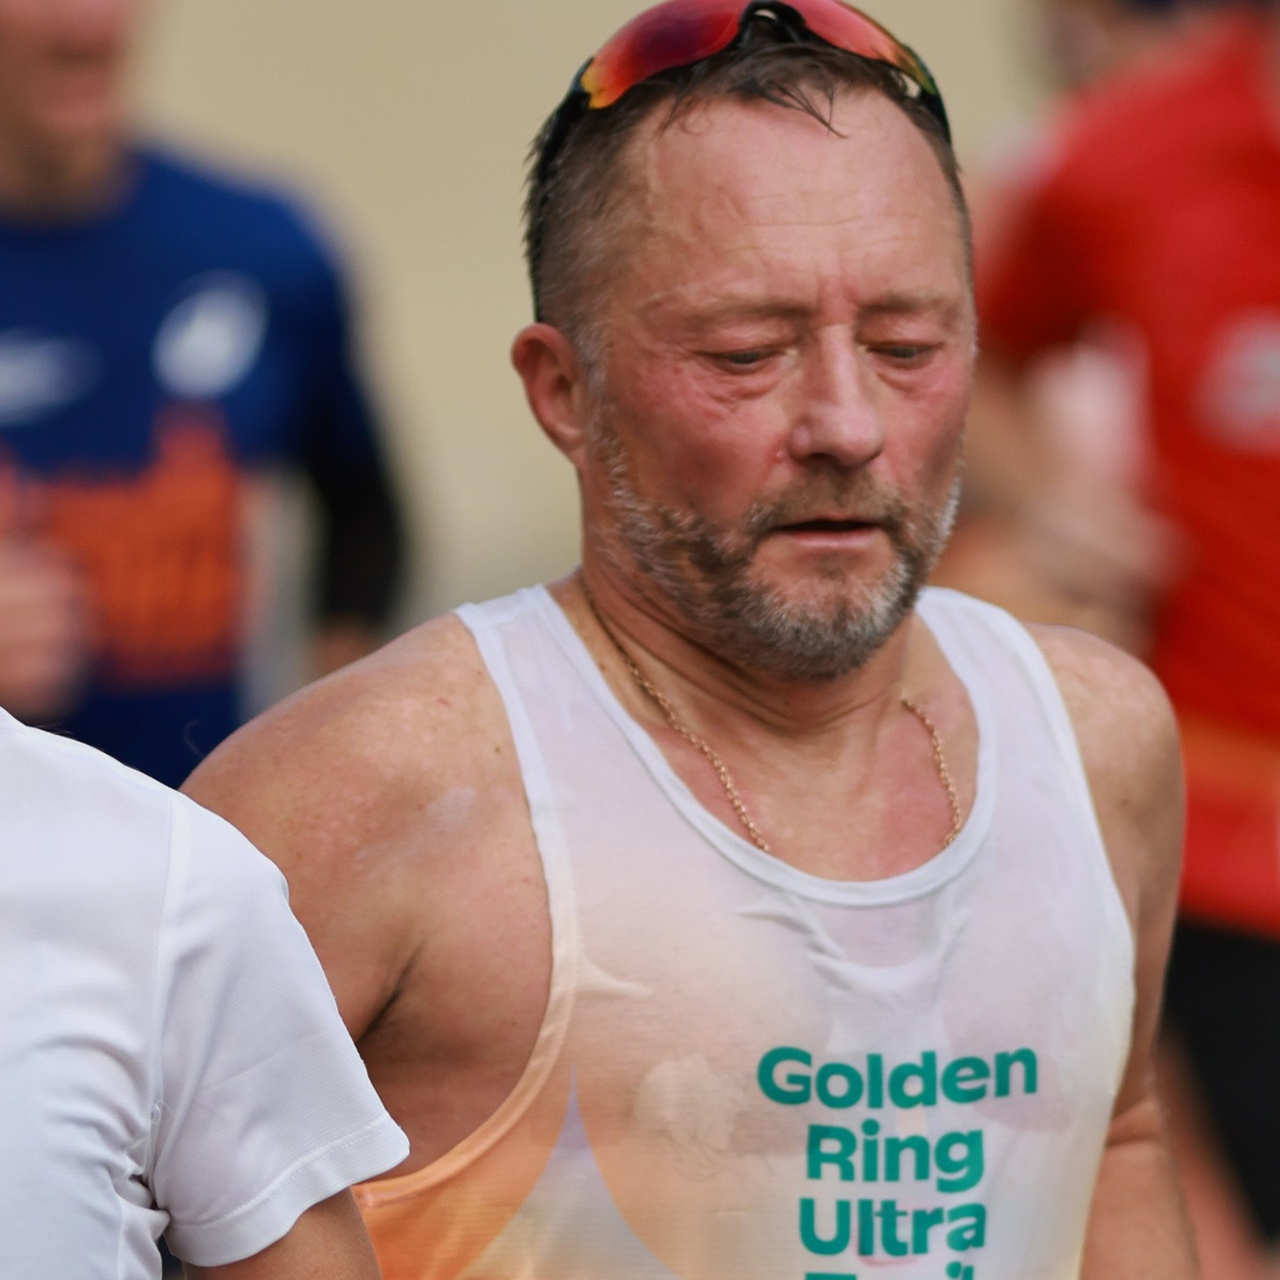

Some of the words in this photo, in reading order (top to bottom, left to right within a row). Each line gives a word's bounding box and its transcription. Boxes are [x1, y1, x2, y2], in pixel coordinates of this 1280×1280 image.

[756, 1046, 1038, 1110] Golden
[806, 1118, 986, 1194] Ring
[798, 1197, 988, 1257] Ultra
